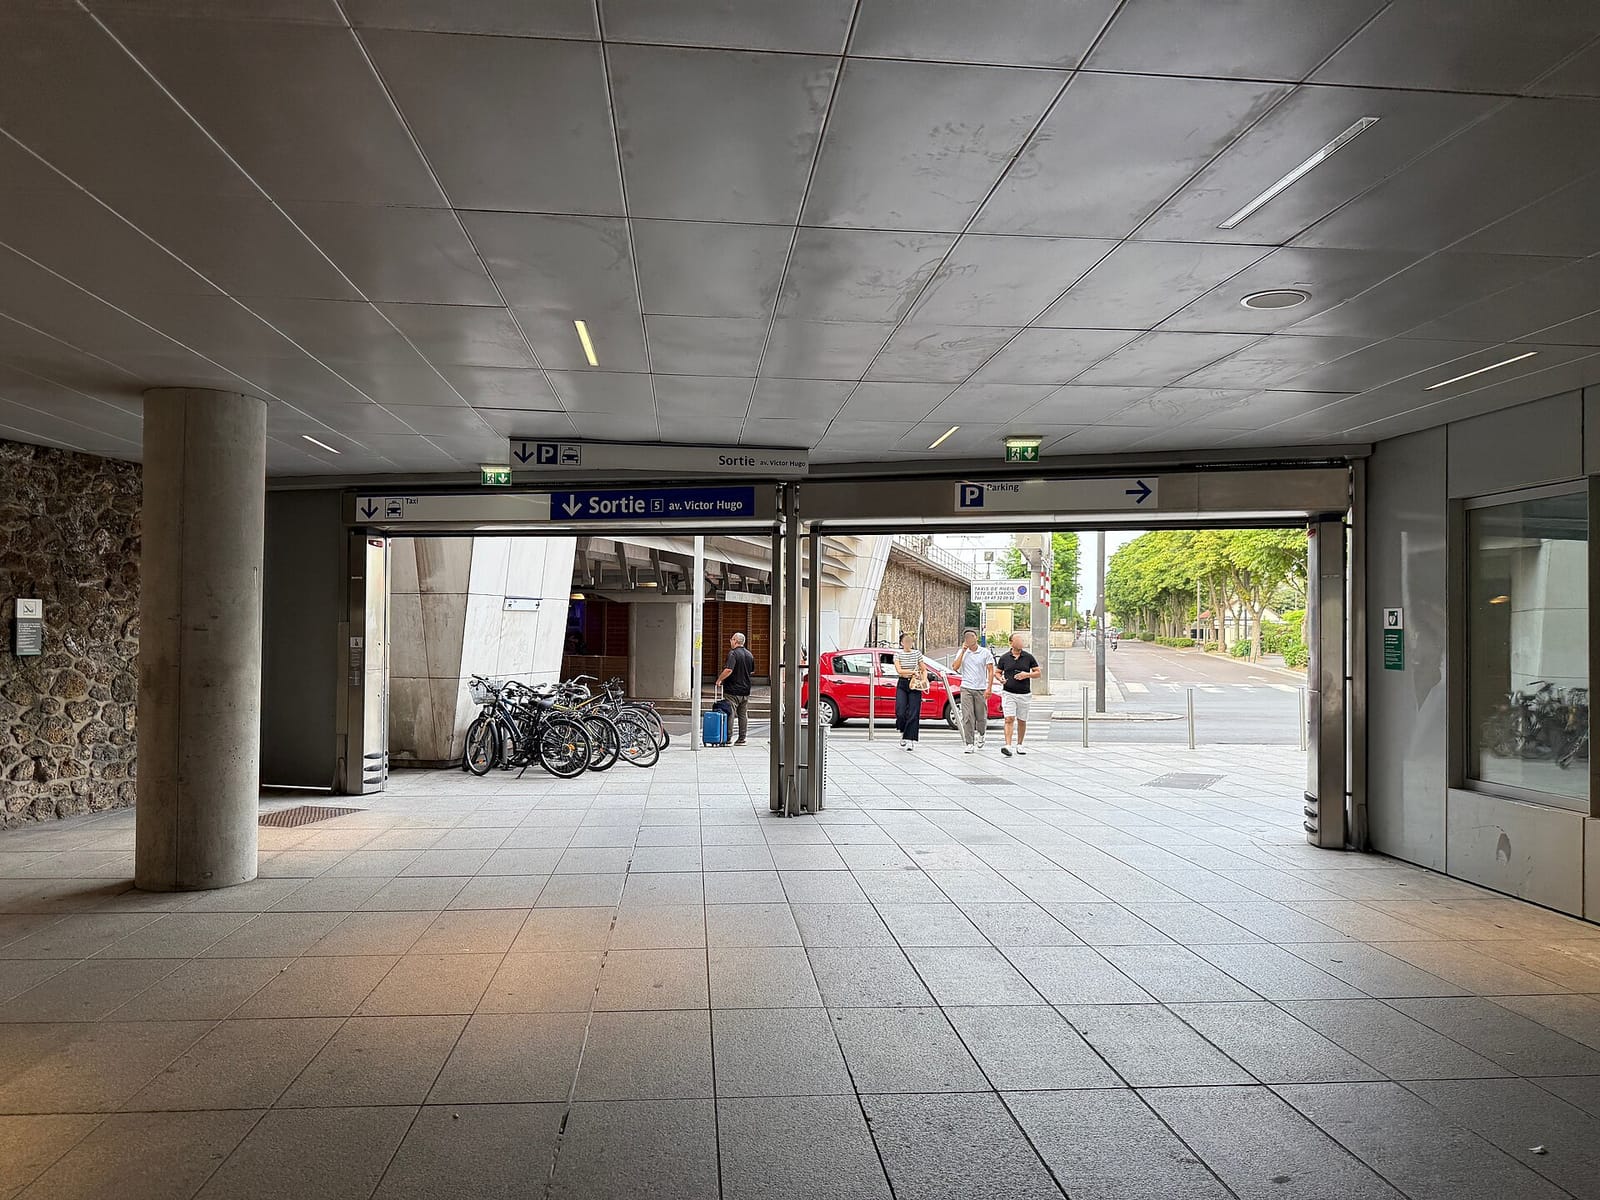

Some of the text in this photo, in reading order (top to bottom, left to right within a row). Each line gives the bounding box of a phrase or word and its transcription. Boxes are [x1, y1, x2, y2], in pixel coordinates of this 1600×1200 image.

[541, 446, 554, 463] P
[718, 455, 756, 466] Sortie
[789, 460, 806, 468] Hugo
[965, 487, 979, 504] P
[986, 483, 1019, 492] Parking
[588, 495, 646, 514] Sortie
[668, 502, 682, 510] av.
[684, 500, 714, 510] Victor
[716, 500, 743, 512] Hugo
